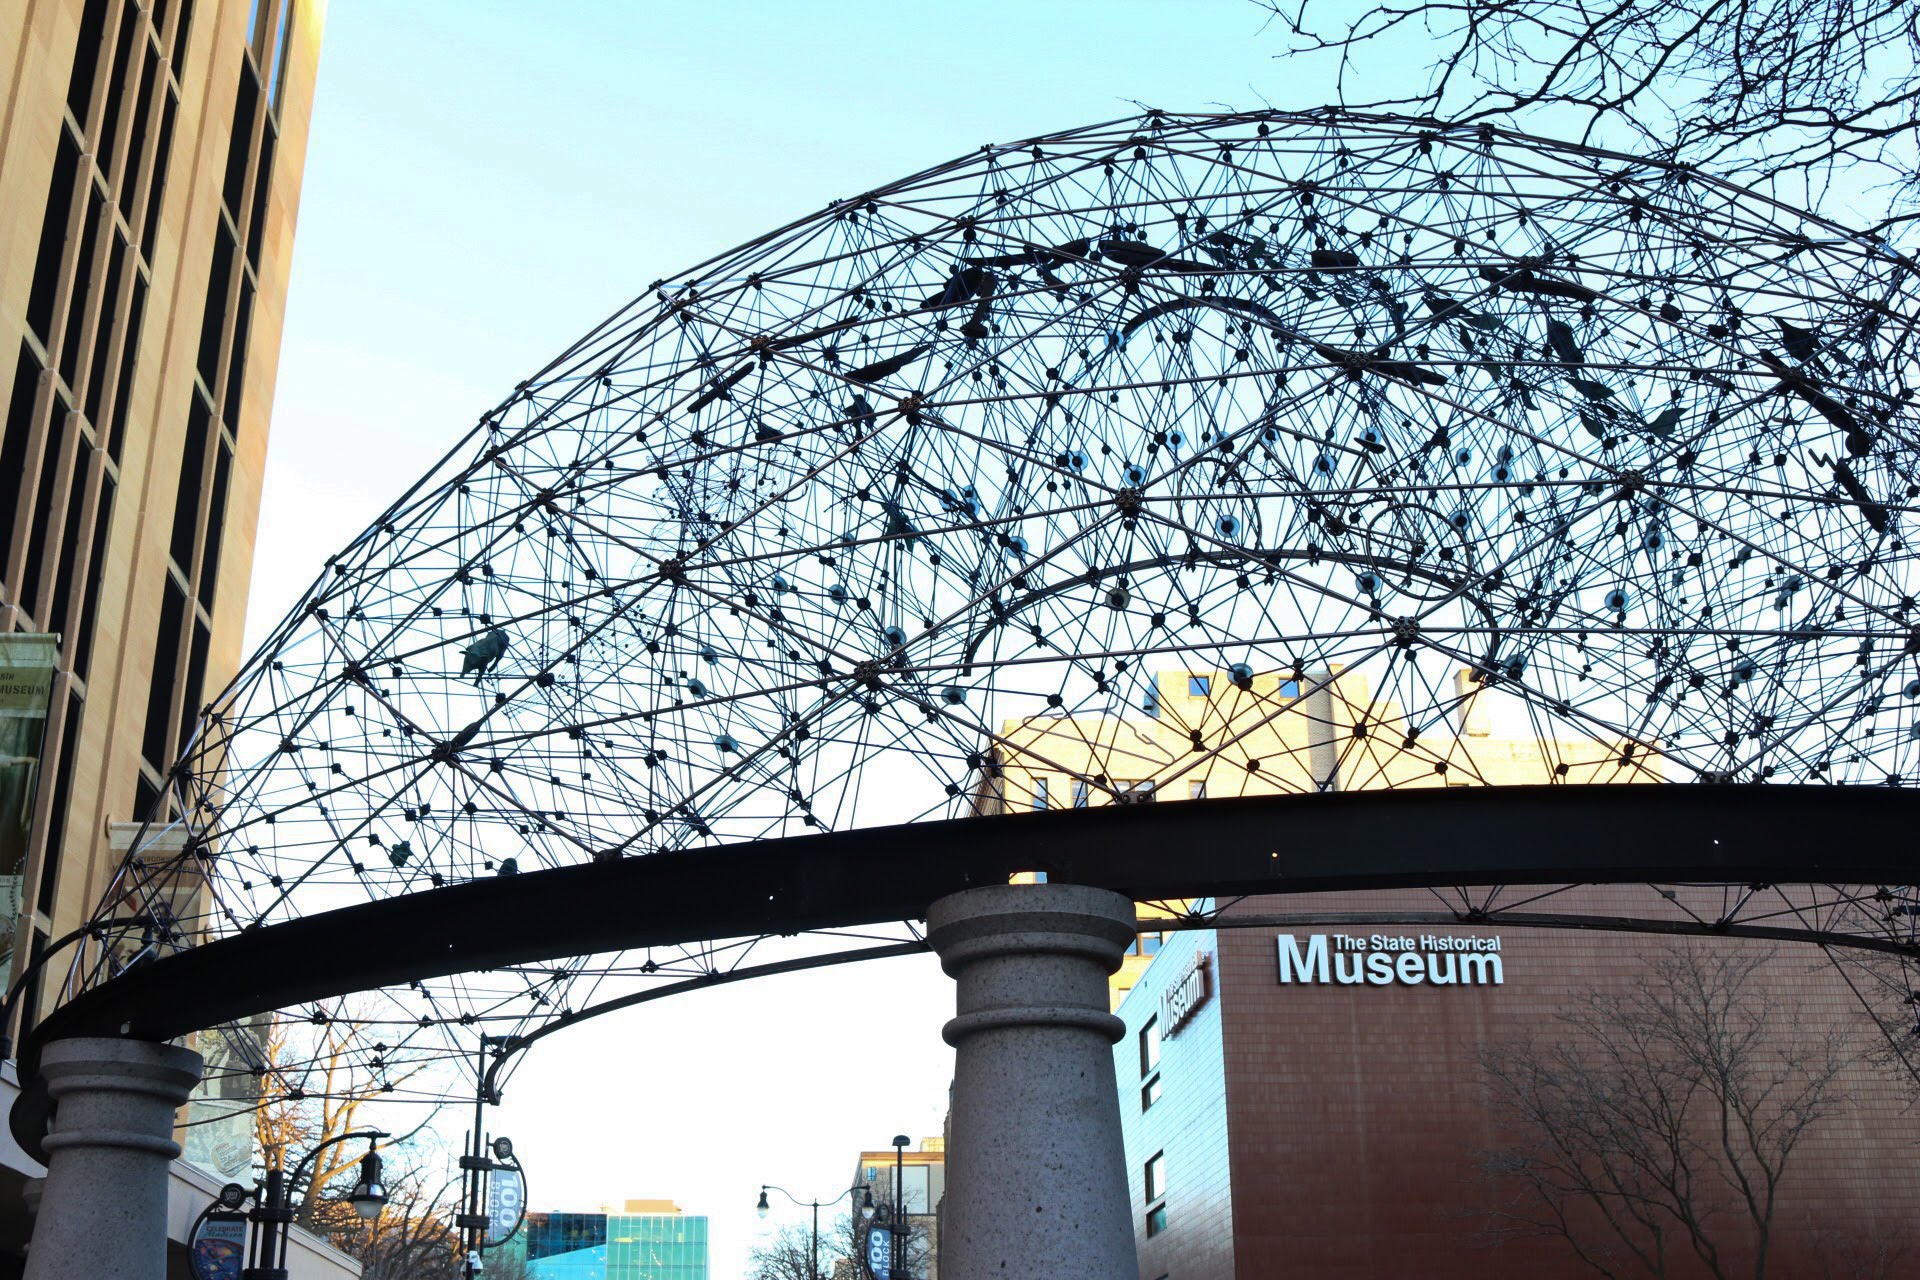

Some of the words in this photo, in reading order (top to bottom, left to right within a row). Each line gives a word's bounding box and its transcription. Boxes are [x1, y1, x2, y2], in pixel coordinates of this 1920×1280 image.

[1277, 934, 1504, 985] Museum
[1333, 934, 1367, 950] The
[1370, 934, 1416, 951] State
[1420, 934, 1502, 951] Historical
[1160, 968, 1205, 1039] Museum
[489, 1181, 500, 1228] BLOCK
[500, 1172, 519, 1228] 100
[871, 1231, 883, 1273] 100
[882, 1240, 890, 1277] BLOCK
